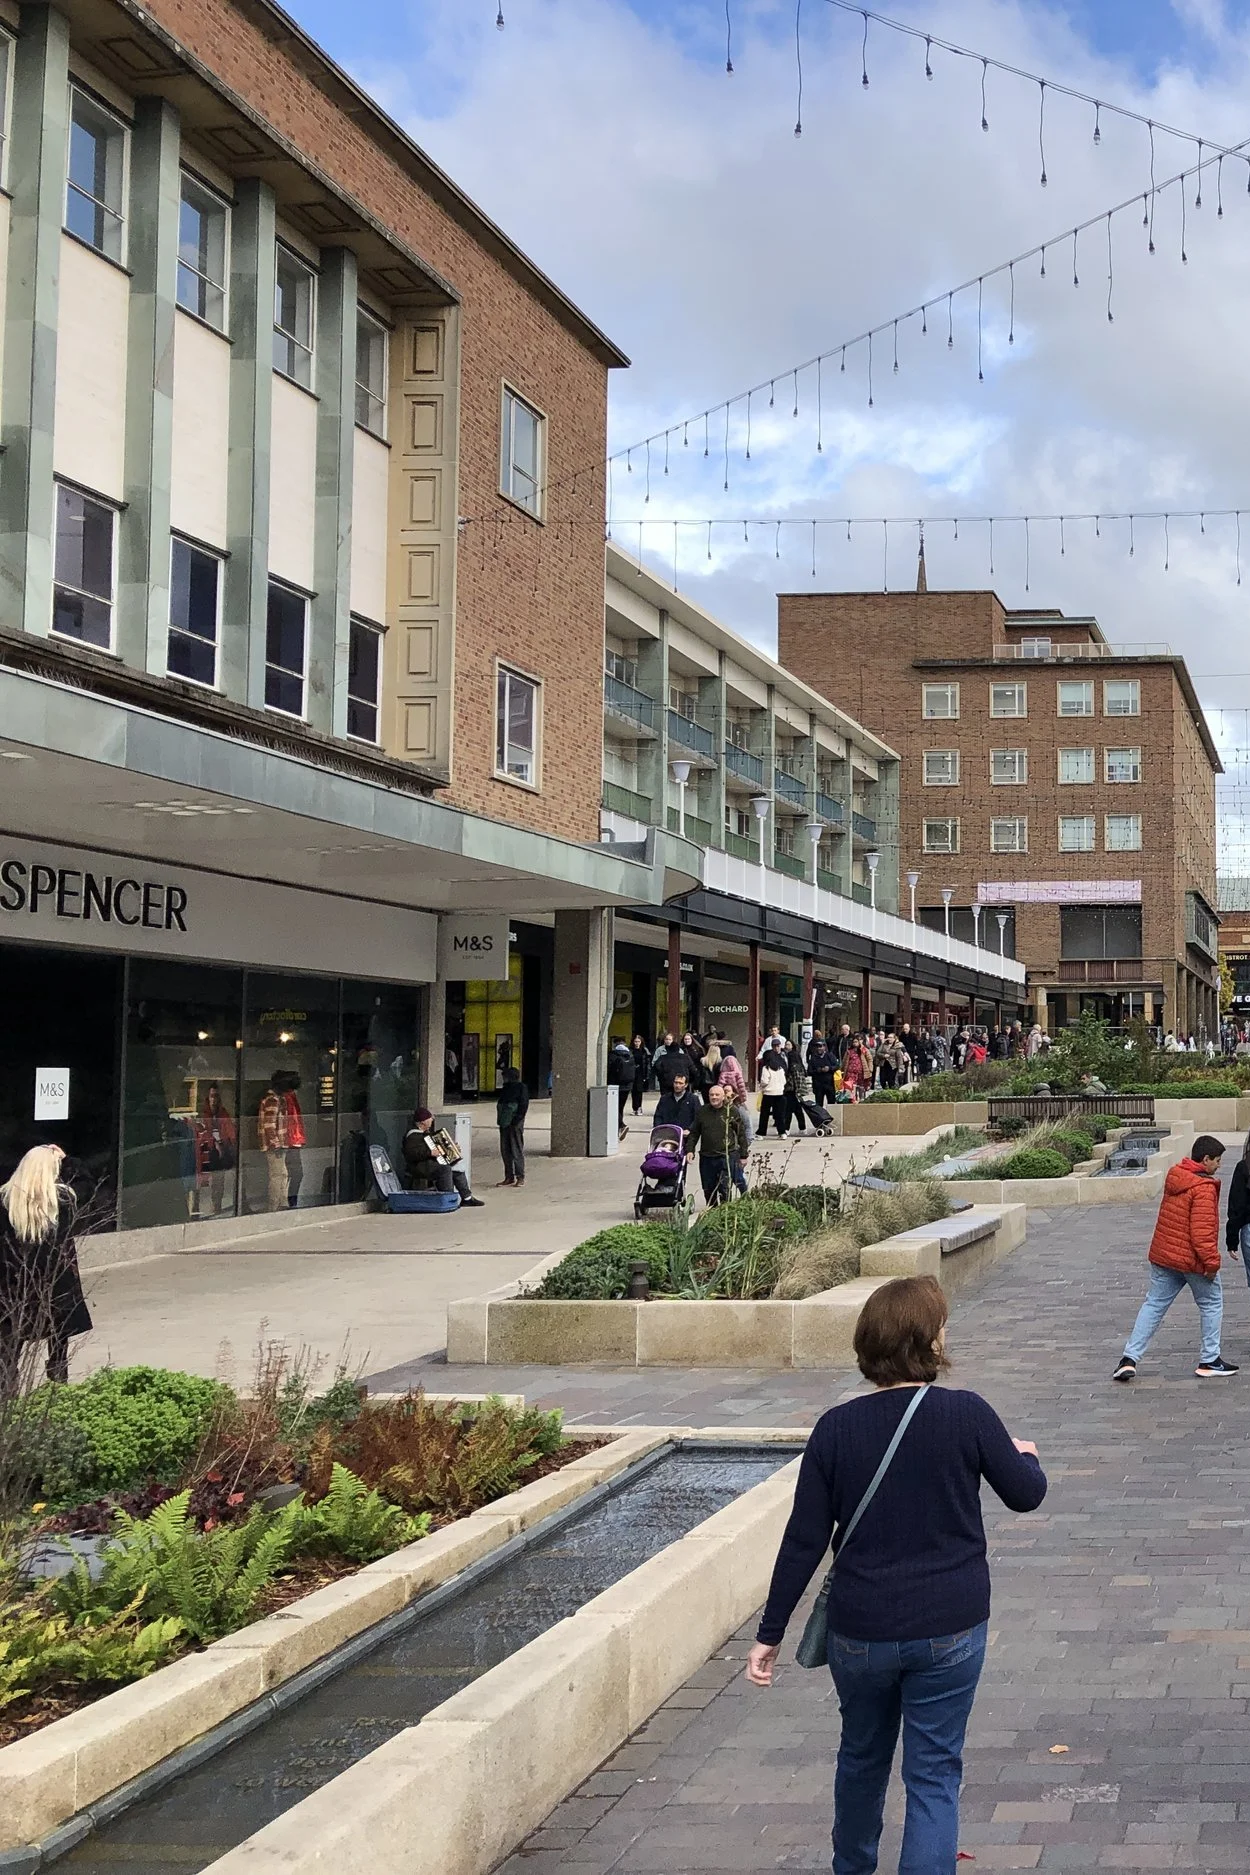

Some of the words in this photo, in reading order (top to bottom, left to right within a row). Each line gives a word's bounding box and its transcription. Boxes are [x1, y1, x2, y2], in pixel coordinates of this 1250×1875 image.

[0, 860, 188, 931] SPENCER
[453, 935, 494, 951] M&S
[1232, 995, 1242, 1003] VE
[708, 1005, 749, 1013] ORCHARD
[40, 1082, 65, 1097] M&S
